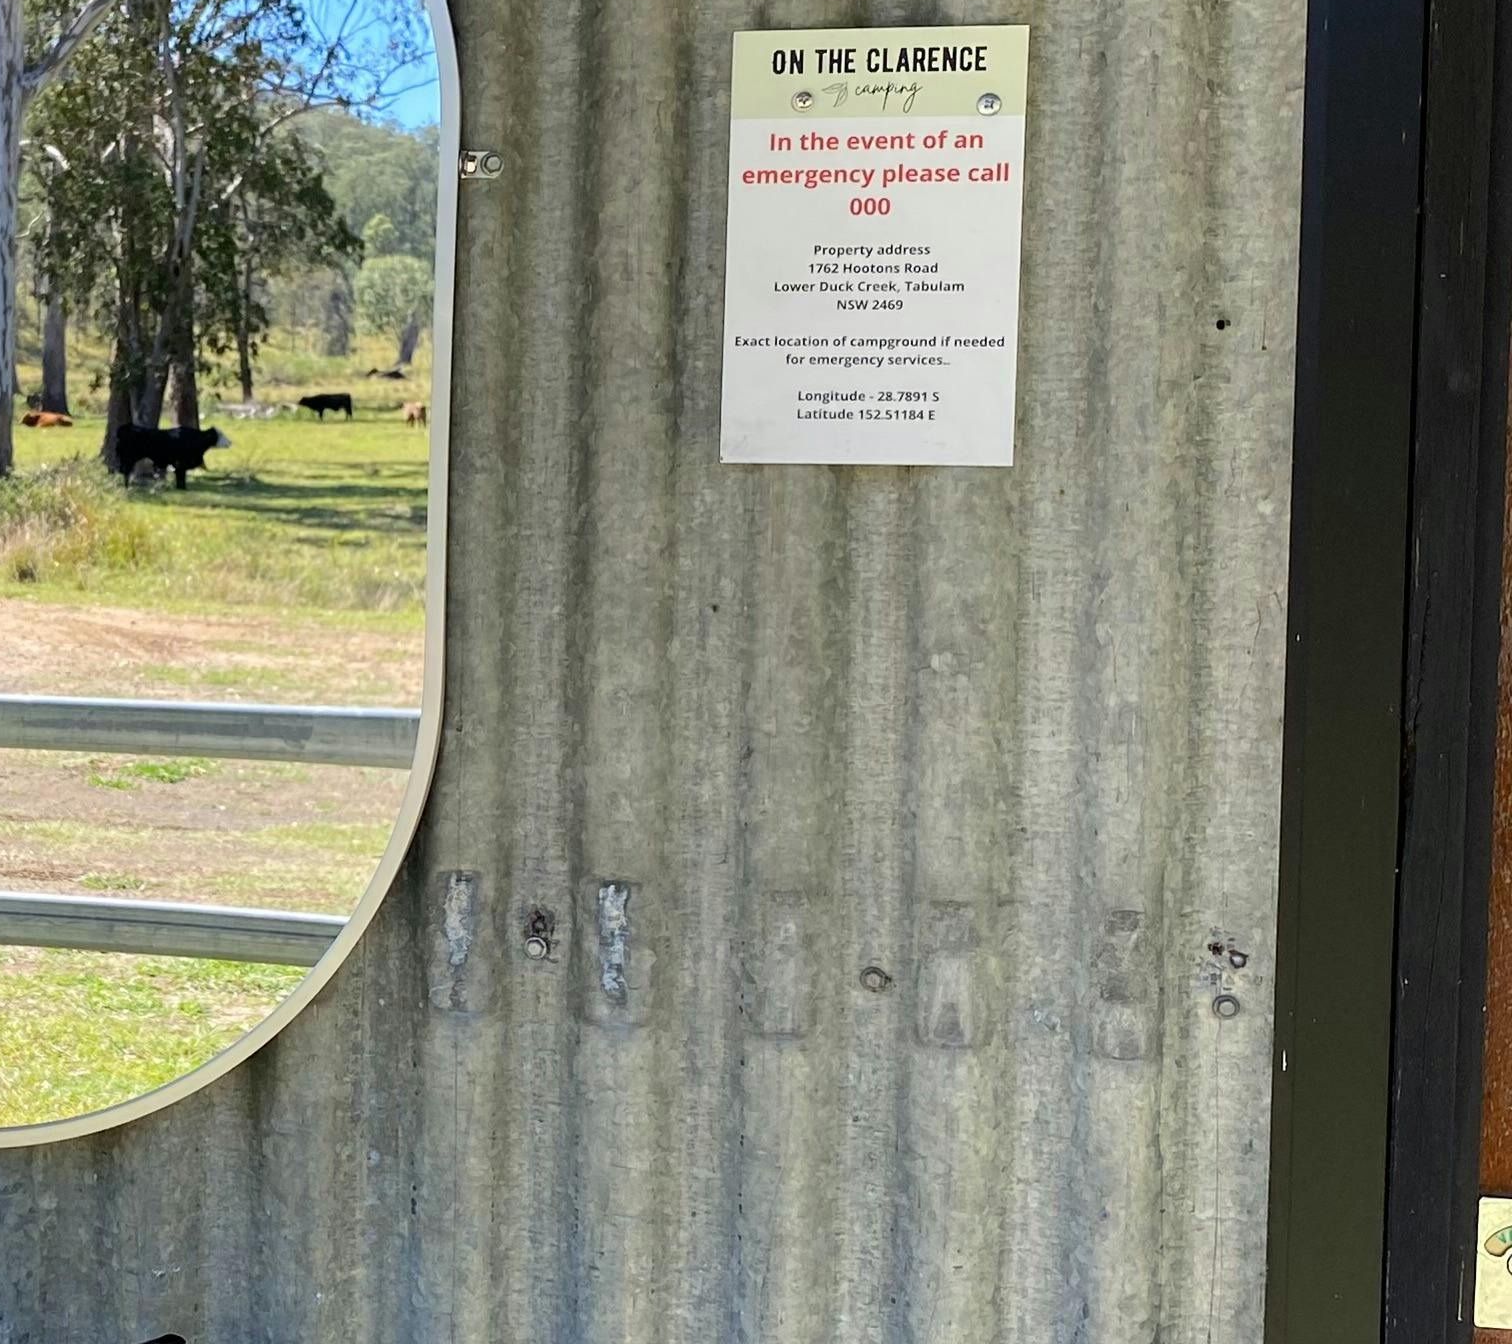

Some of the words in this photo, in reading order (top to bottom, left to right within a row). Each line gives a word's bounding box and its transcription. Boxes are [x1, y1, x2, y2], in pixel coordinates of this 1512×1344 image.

[772, 49, 805, 74] ON
[815, 48, 856, 73] THE
[866, 46, 987, 73] CLARENCE
[855, 81, 923, 113] camping
[769, 133, 791, 151] In
[799, 132, 839, 150] the
[847, 133, 915, 150] event
[923, 130, 948, 149] of
[954, 133, 983, 148] an
[742, 167, 875, 188] emergency
[882, 164, 960, 186] please
[968, 163, 1009, 181] call
[850, 198, 891, 216] 000
[814, 245, 873, 258] Property
[877, 245, 930, 255] address
[808, 263, 839, 274] 1762
[843, 263, 900, 273] Hootons
[904, 263, 938, 273] Road
[774, 282, 815, 292] Lower
[819, 281, 854, 292] Duck
[857, 281, 900, 293] Creek,
[905, 281, 964, 292] Tabulam
[837, 300, 868, 310] NSW
[872, 299, 903, 310] 2469
[735, 336, 771, 347] Exact
[774, 336, 828, 347] location
[833, 336, 847, 347] of
[850, 336, 937, 350] campground
[941, 336, 950, 347] if
[954, 336, 1005, 348] needed
[786, 354, 803, 365] for
[809, 356, 884, 368] emergency
[798, 391, 866, 404] Longitude
[877, 391, 927, 402] 28.7891
[932, 392, 939, 402] S
[797, 409, 853, 420] Latitude
[858, 410, 924, 420] 152.51184
[929, 410, 936, 420] E
